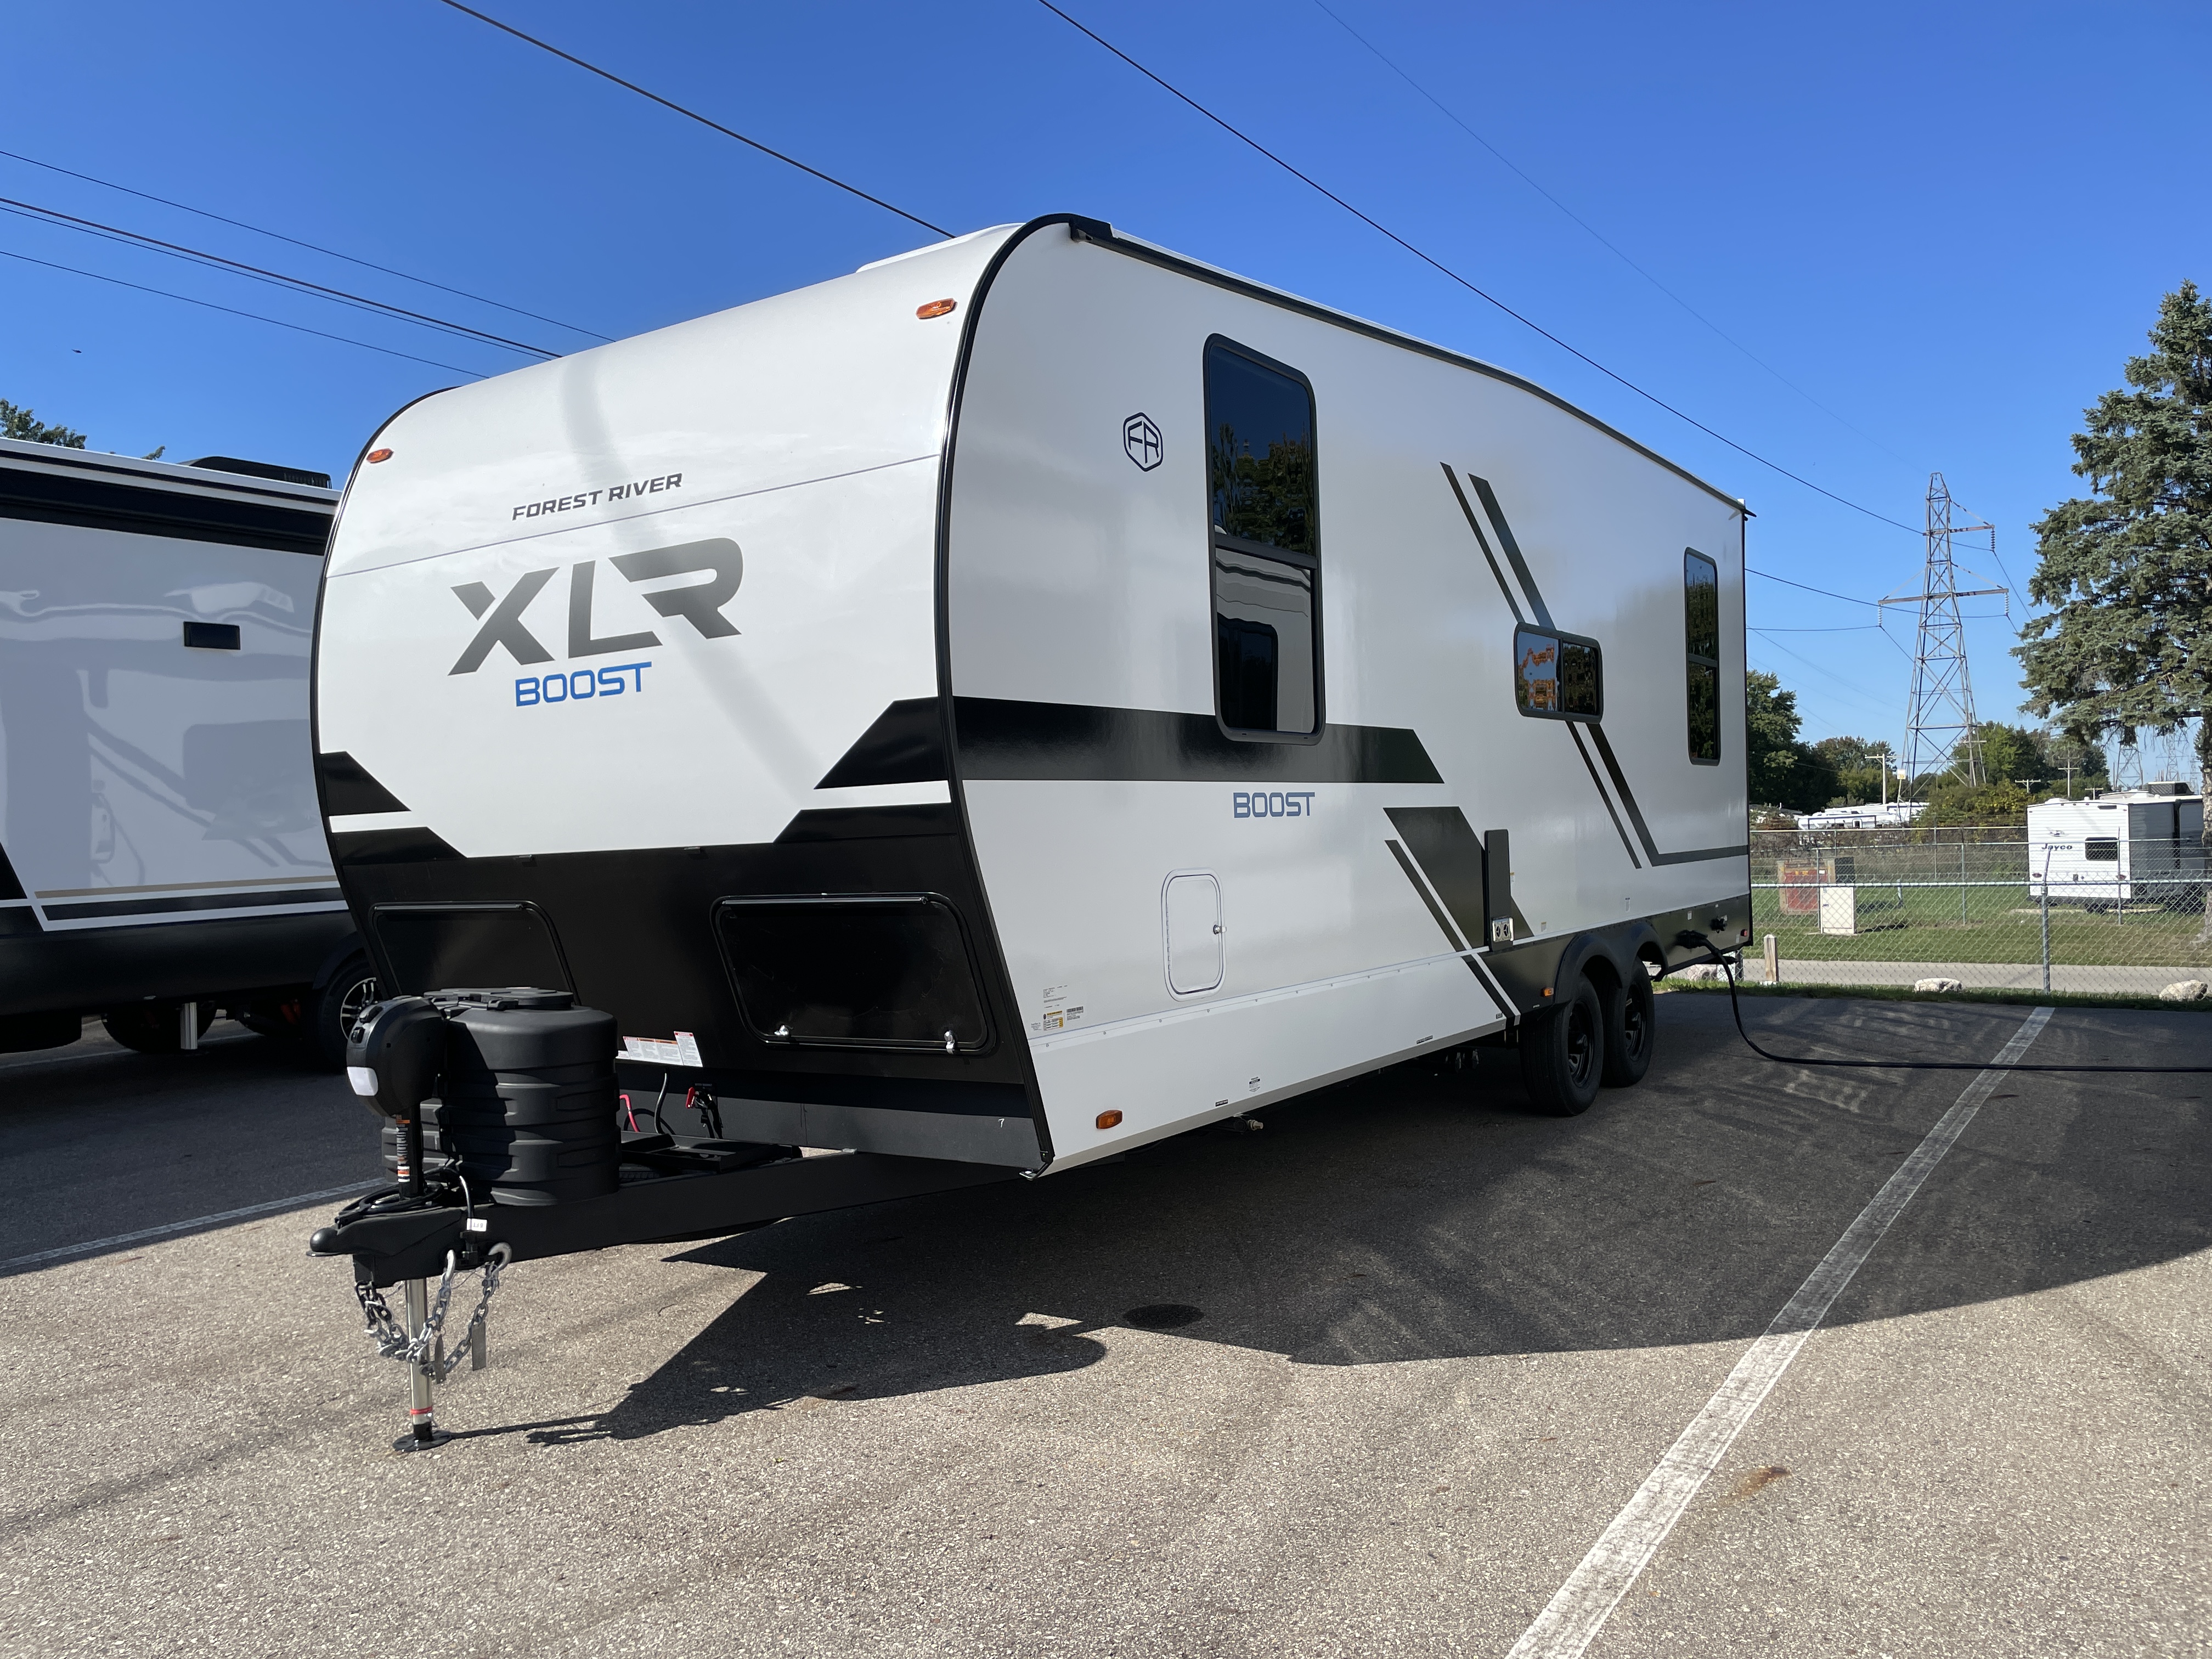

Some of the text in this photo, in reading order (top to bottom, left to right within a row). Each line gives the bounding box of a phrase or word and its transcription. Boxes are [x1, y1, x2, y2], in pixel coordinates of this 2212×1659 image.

[511, 472, 682, 521] FOREST RIVER
[447, 537, 744, 676] XLR
[515, 661, 652, 707] BOOST
[1233, 792, 1316, 819] BOOST
